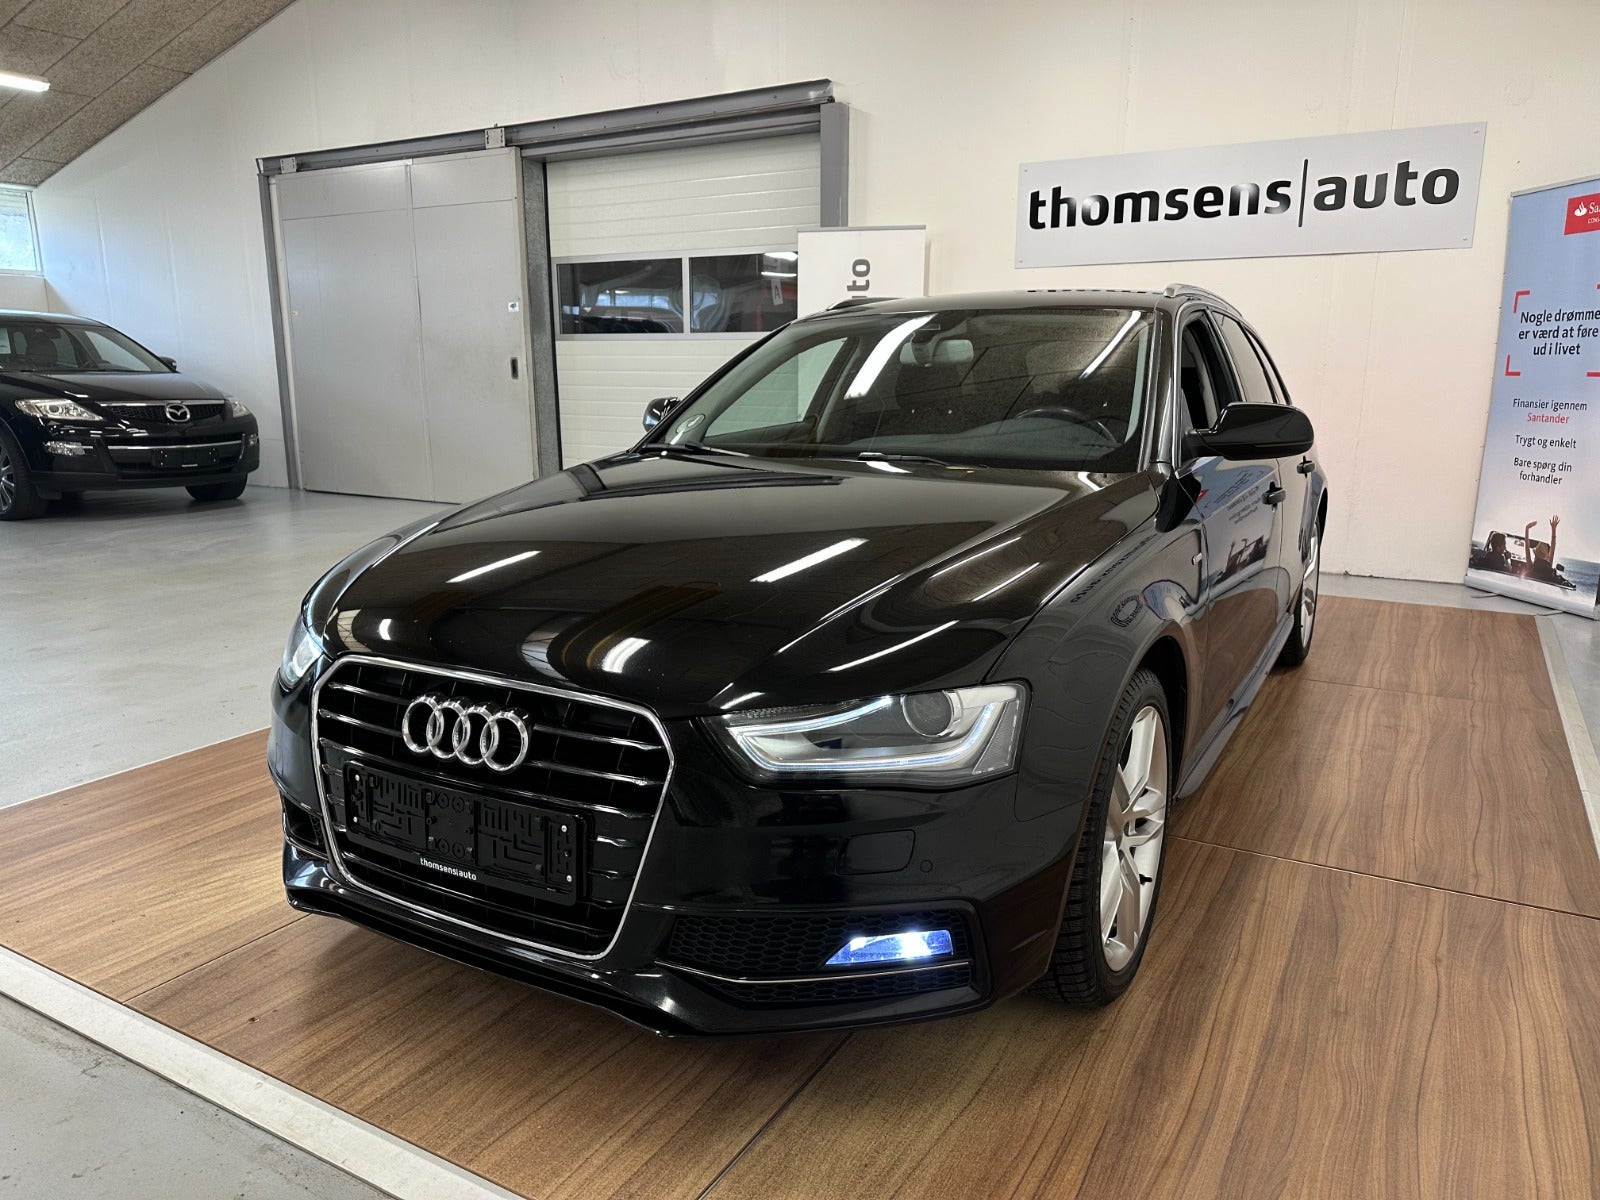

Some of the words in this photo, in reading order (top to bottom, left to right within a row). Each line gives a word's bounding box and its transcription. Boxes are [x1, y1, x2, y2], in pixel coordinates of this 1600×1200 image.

[1520, 309, 1553, 326] Nogle
[1554, 308, 1600, 322] drømme
[1518, 330, 1531, 340] er
[1532, 325, 1560, 340] værd
[1562, 326, 1575, 338] at
[1577, 324, 1599, 339] føre
[1533, 342, 1548, 356] ud
[1548, 342, 1553, 356] i
[1554, 341, 1581, 356] livet
[1512, 398, 1550, 409] Finansier
[1550, 399, 1588, 413] igennem
[1527, 412, 1570, 424] Santander
[1515, 434, 1536, 448] Trygt
[1537, 438, 1549, 449] og
[1549, 437, 1577, 449] enkelt
[1513, 457, 1532, 468] Bare
[1533, 461, 1556, 473] spørg
[1558, 461, 1573, 473] din
[1519, 470, 1563, 485] forhandler
